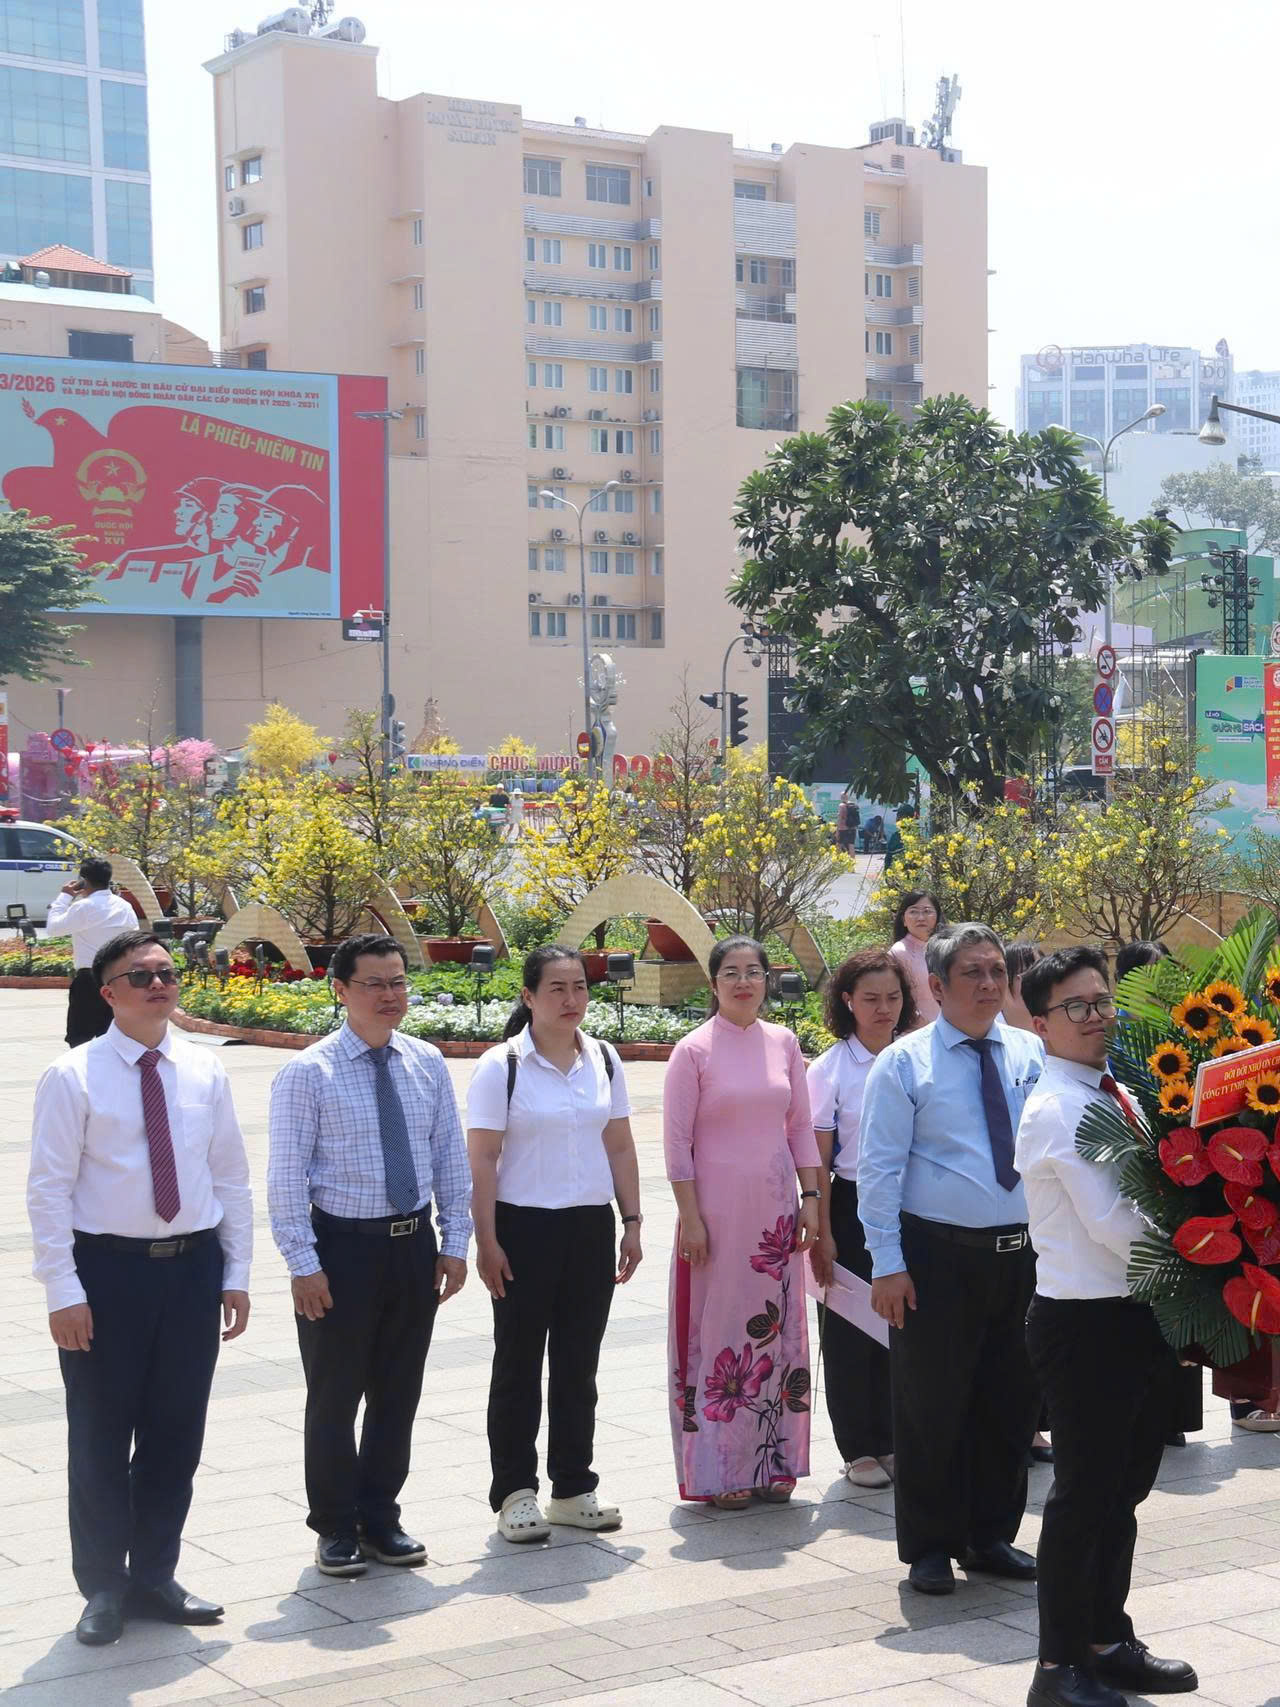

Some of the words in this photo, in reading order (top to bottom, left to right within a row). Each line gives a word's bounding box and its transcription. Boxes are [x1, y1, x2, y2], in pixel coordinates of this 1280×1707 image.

[1071, 350, 1145, 365] Hanwha
[1148, 349, 1181, 362] Life
[78, 378, 93, 387] TRI
[180, 415, 200, 436] LÁ
[300, 449, 326, 472] TIN
[104, 536, 125, 545] XVI
[1202, 1086, 1221, 1102] CÔNG
